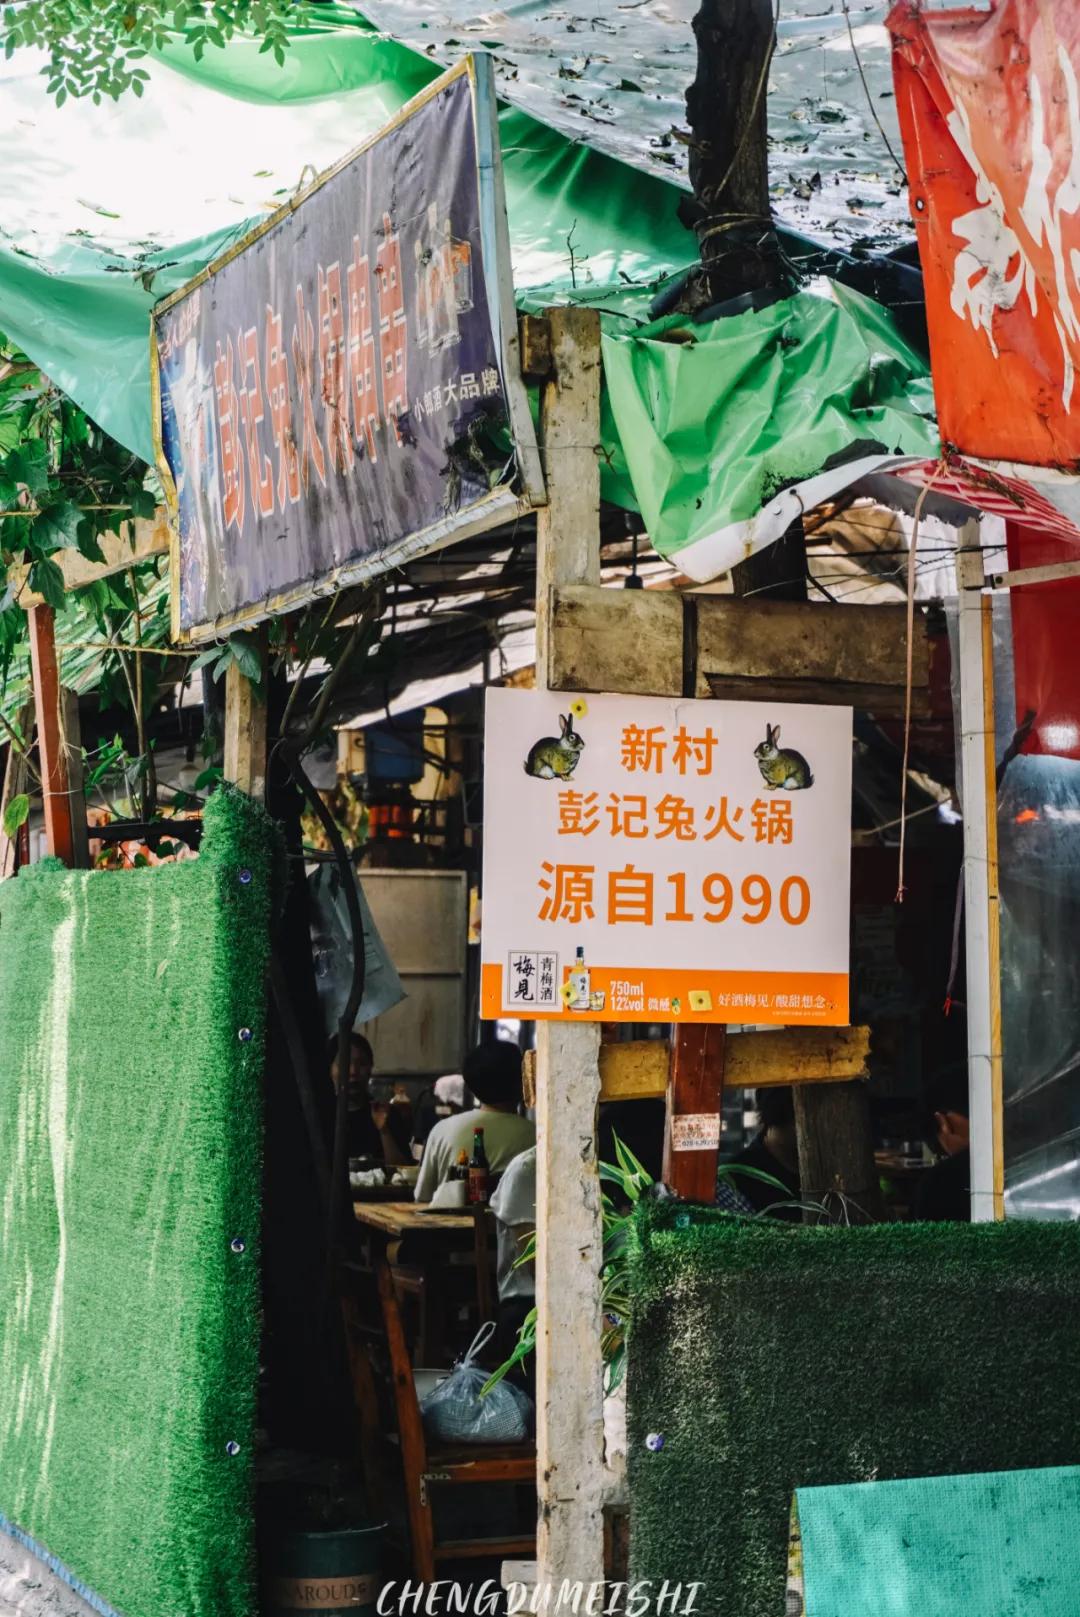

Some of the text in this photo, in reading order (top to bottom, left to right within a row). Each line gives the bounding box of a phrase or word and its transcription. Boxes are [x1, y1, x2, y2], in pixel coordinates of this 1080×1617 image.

[620, 723, 719, 776] 新村
[557, 789, 794, 845] 彭记兔火锅
[537, 860, 811, 926] 源自1990
[540, 956, 555, 1001] 青梅酒
[610, 980, 644, 996] 750ml
[610, 996, 645, 1012] 12%vol
